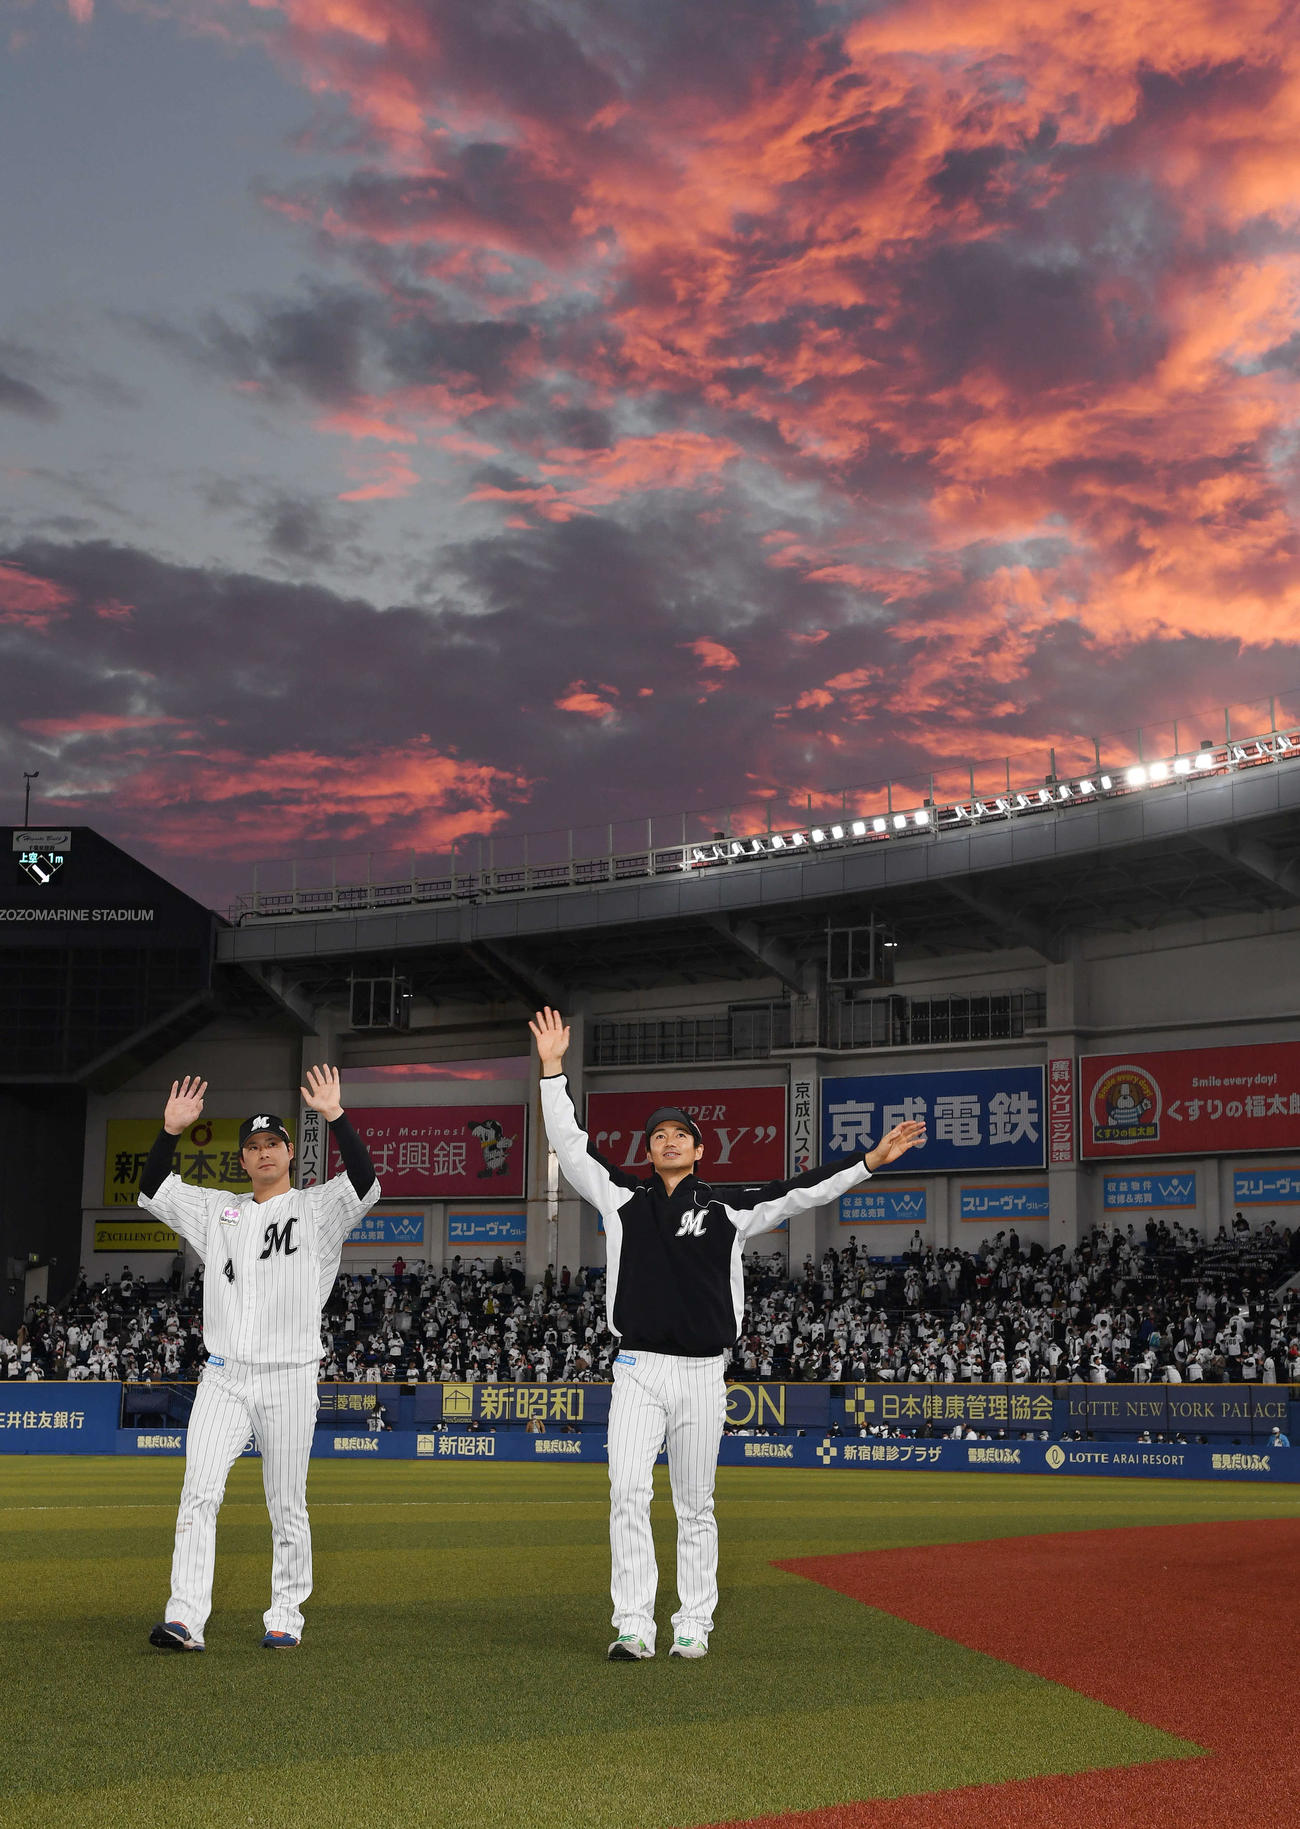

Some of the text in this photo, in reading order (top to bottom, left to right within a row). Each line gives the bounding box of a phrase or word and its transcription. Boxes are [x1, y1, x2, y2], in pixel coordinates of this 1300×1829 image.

[19, 852, 63, 863] 上空 1m
[92, 909, 154, 921] STADIUM
[680, 1105, 727, 1121] PER
[794, 1082, 811, 1153] 京成バス
[828, 1091, 1039, 1151] 京成電鉄
[251, 1116, 270, 1131] M
[366, 1127, 390, 1137] Go!
[399, 1126, 465, 1137] Marines!
[303, 1110, 319, 1176] 京成バス
[675, 1208, 709, 1237] M
[258, 1218, 298, 1260] M
[223, 1258, 235, 1284] 4
[319, 1394, 377, 1411] 三菱電機
[480, 1386, 584, 1420] 新昭和
[882, 1394, 1053, 1420] 日本健康管理協会
[1069, 1401, 1287, 1418] LOTTE NEW YORK PALACE
[438, 1435, 495, 1456] 新昭和
[535, 1439, 582, 1454] 雪見だいふく
[744, 1443, 794, 1458] 雪見だいふく
[843, 1444, 942, 1462] 新宿健診プラザ
[968, 1448, 1021, 1464] 雪見だいふく
[1069, 1452, 1185, 1465] LOTTE ARAI RESORT
[1211, 1453, 1270, 1471] 雪見だいふく
